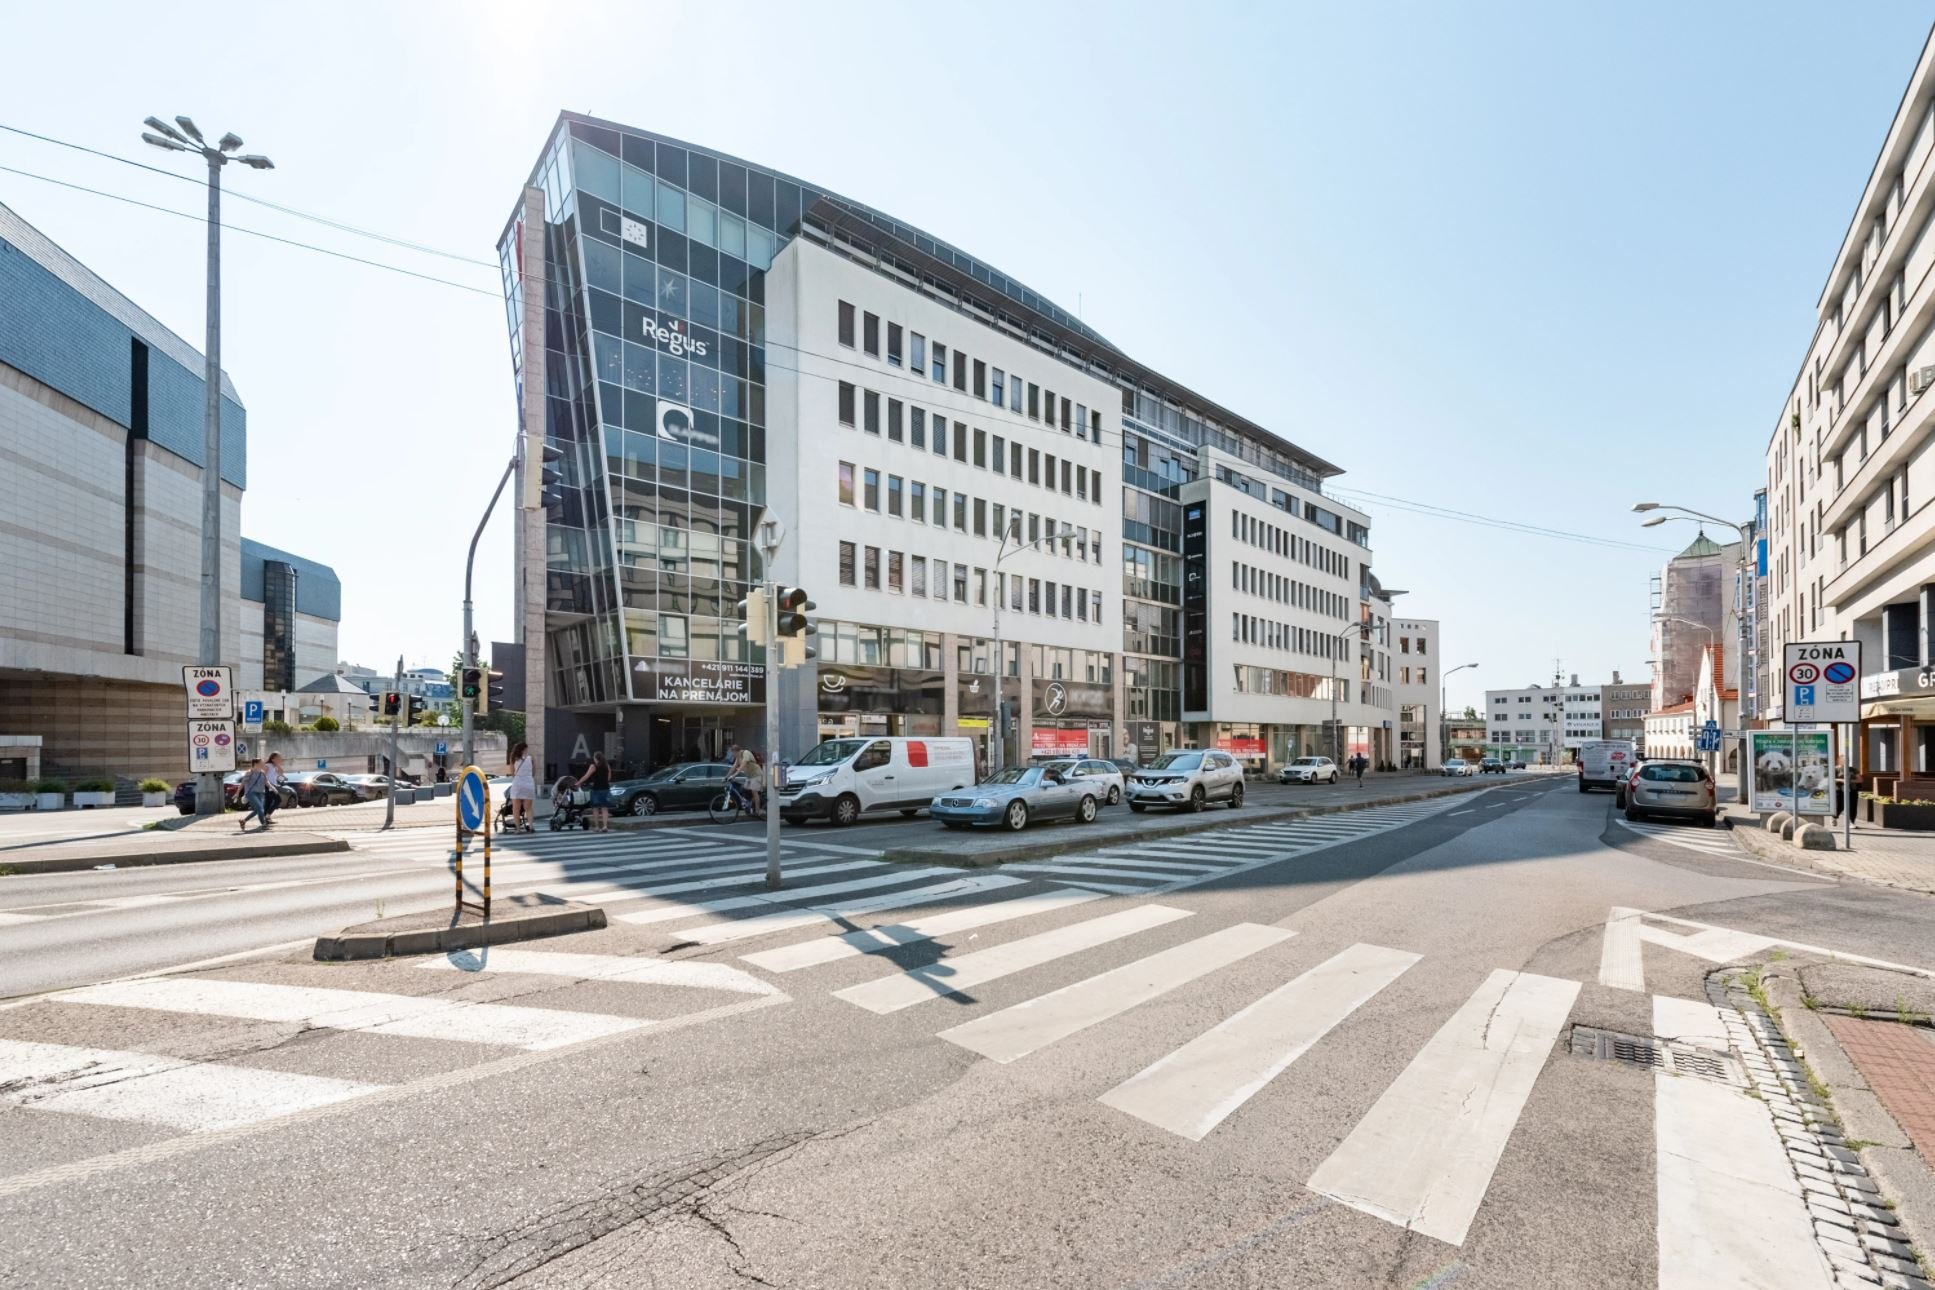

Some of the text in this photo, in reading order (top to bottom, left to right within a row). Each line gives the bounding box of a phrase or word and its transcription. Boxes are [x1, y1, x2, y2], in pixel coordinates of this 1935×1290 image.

[642, 317, 707, 356] Regus
[1798, 644, 1845, 661] ZÓNA
[193, 667, 222, 678] ZÓNA
[1797, 668, 1813, 679] 30
[659, 689, 679, 700] NA
[197, 721, 226, 732] ZÓNA
[570, 733, 592, 759] A
